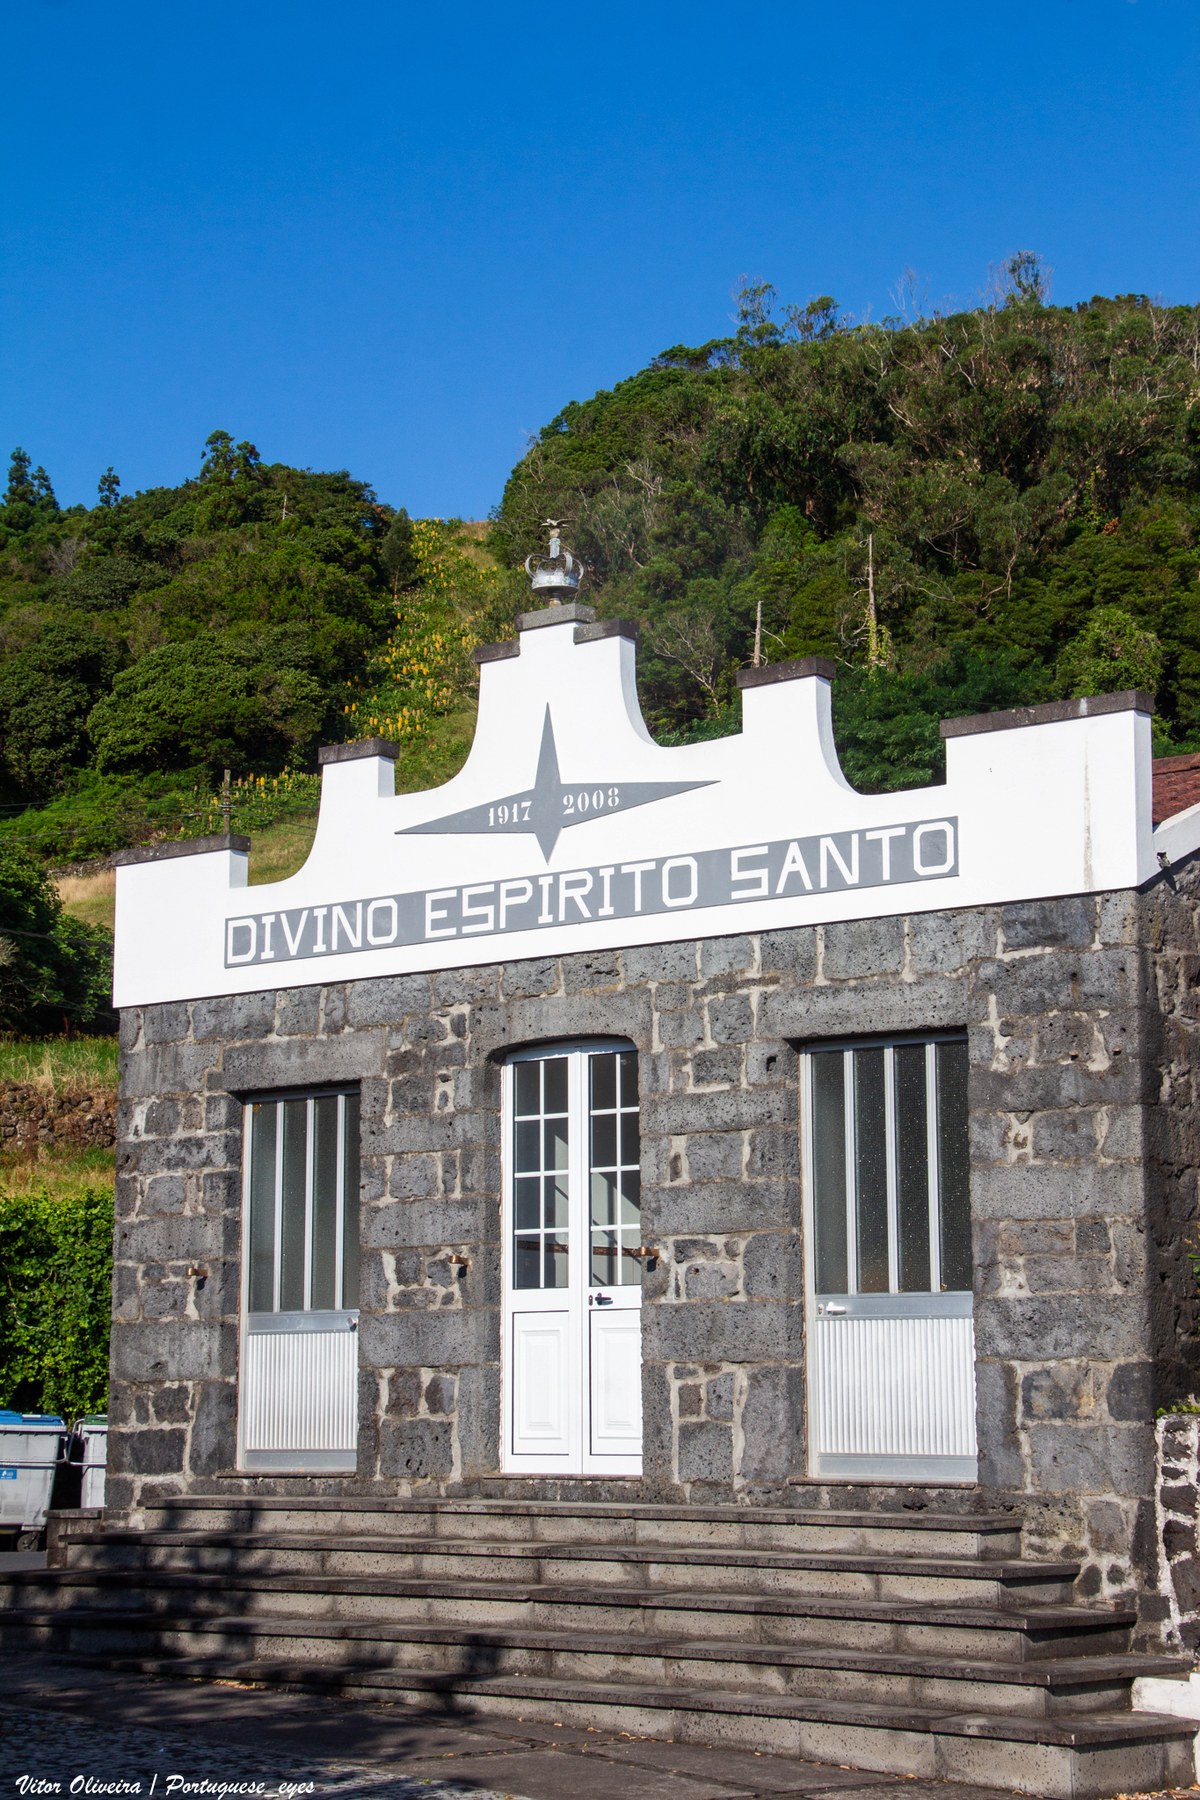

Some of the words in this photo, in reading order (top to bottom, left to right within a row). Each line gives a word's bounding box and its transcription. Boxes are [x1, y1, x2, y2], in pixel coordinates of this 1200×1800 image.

[488, 801, 532, 827] 1917
[562, 787, 620, 815] 2008
[227, 898, 398, 965] DIVINO
[425, 856, 698, 939] ESPIRITO
[730, 821, 955, 900] SANTO
